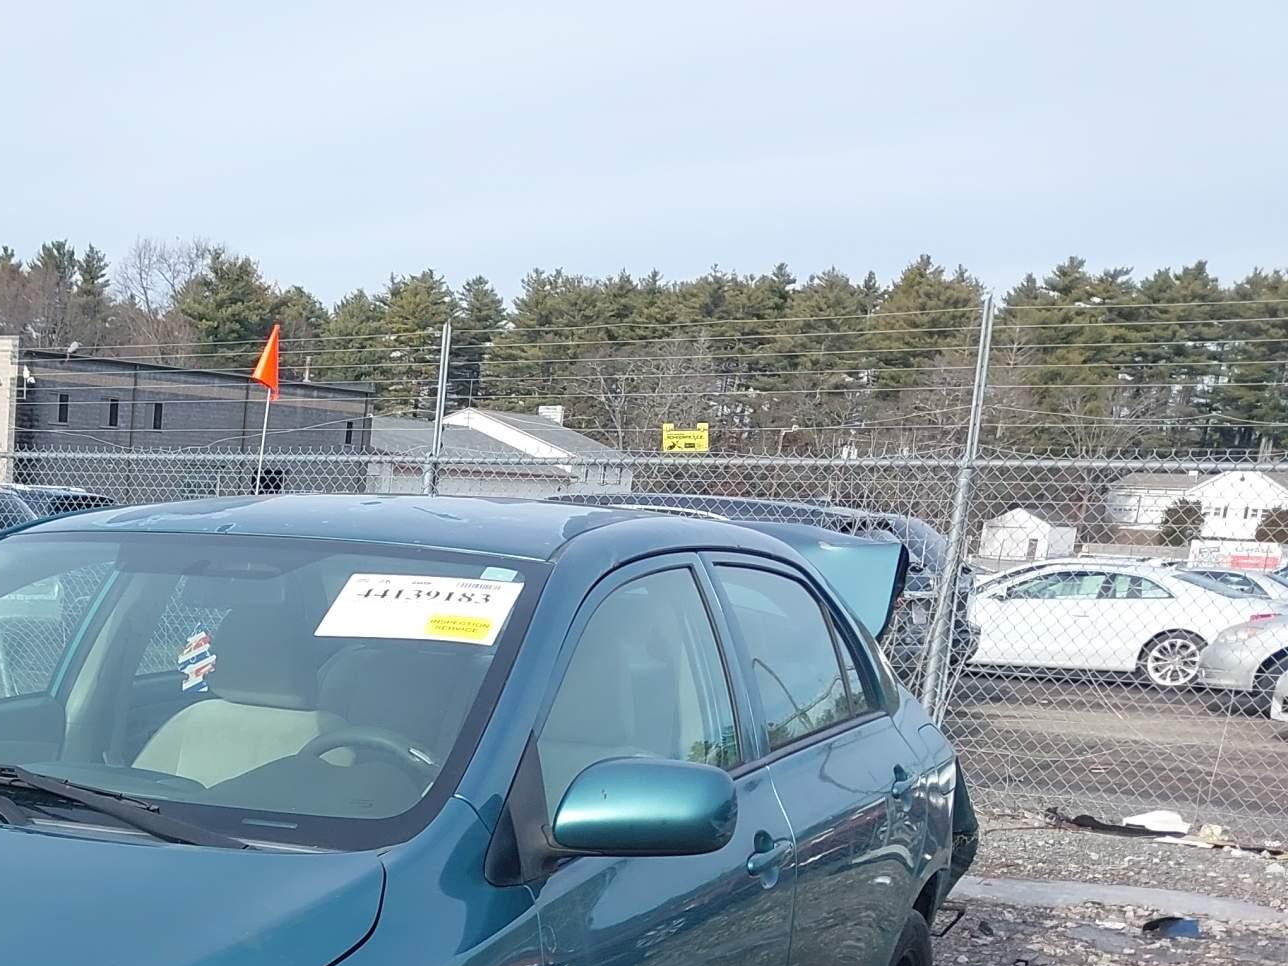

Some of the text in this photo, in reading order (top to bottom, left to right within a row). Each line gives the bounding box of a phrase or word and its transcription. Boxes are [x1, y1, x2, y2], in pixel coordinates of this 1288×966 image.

[357, 587, 491, 604] 44139183
[430, 618, 490, 629] INSPECTION
[434, 625, 480, 633] SERVICE
